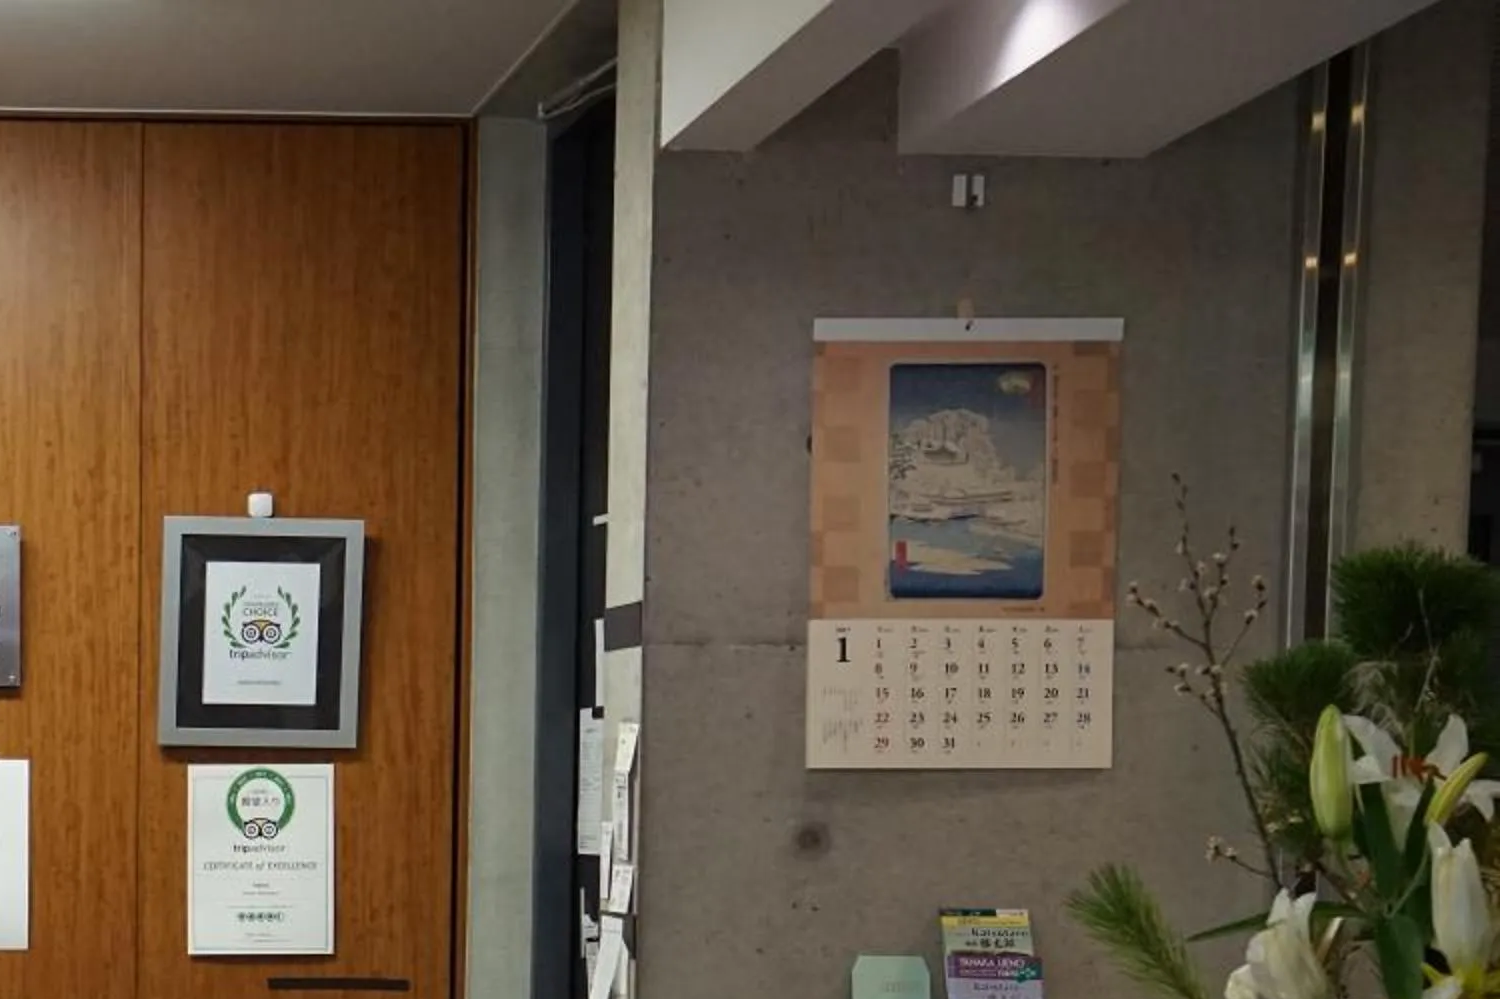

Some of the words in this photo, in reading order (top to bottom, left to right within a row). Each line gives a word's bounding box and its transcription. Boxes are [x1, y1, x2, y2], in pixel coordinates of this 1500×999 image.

[837, 637, 850, 662] 1
[1011, 663, 1025, 674] 12
[910, 687, 924, 699] 16
[944, 687, 957, 699] 17
[978, 687, 991, 699] 18
[1011, 687, 1025, 699] 19
[1044, 687, 1059, 699] 20
[1010, 712, 1025, 724] 26
[1043, 712, 1058, 724] 27
[909, 737, 925, 749] 30
[943, 737, 956, 749] 31
